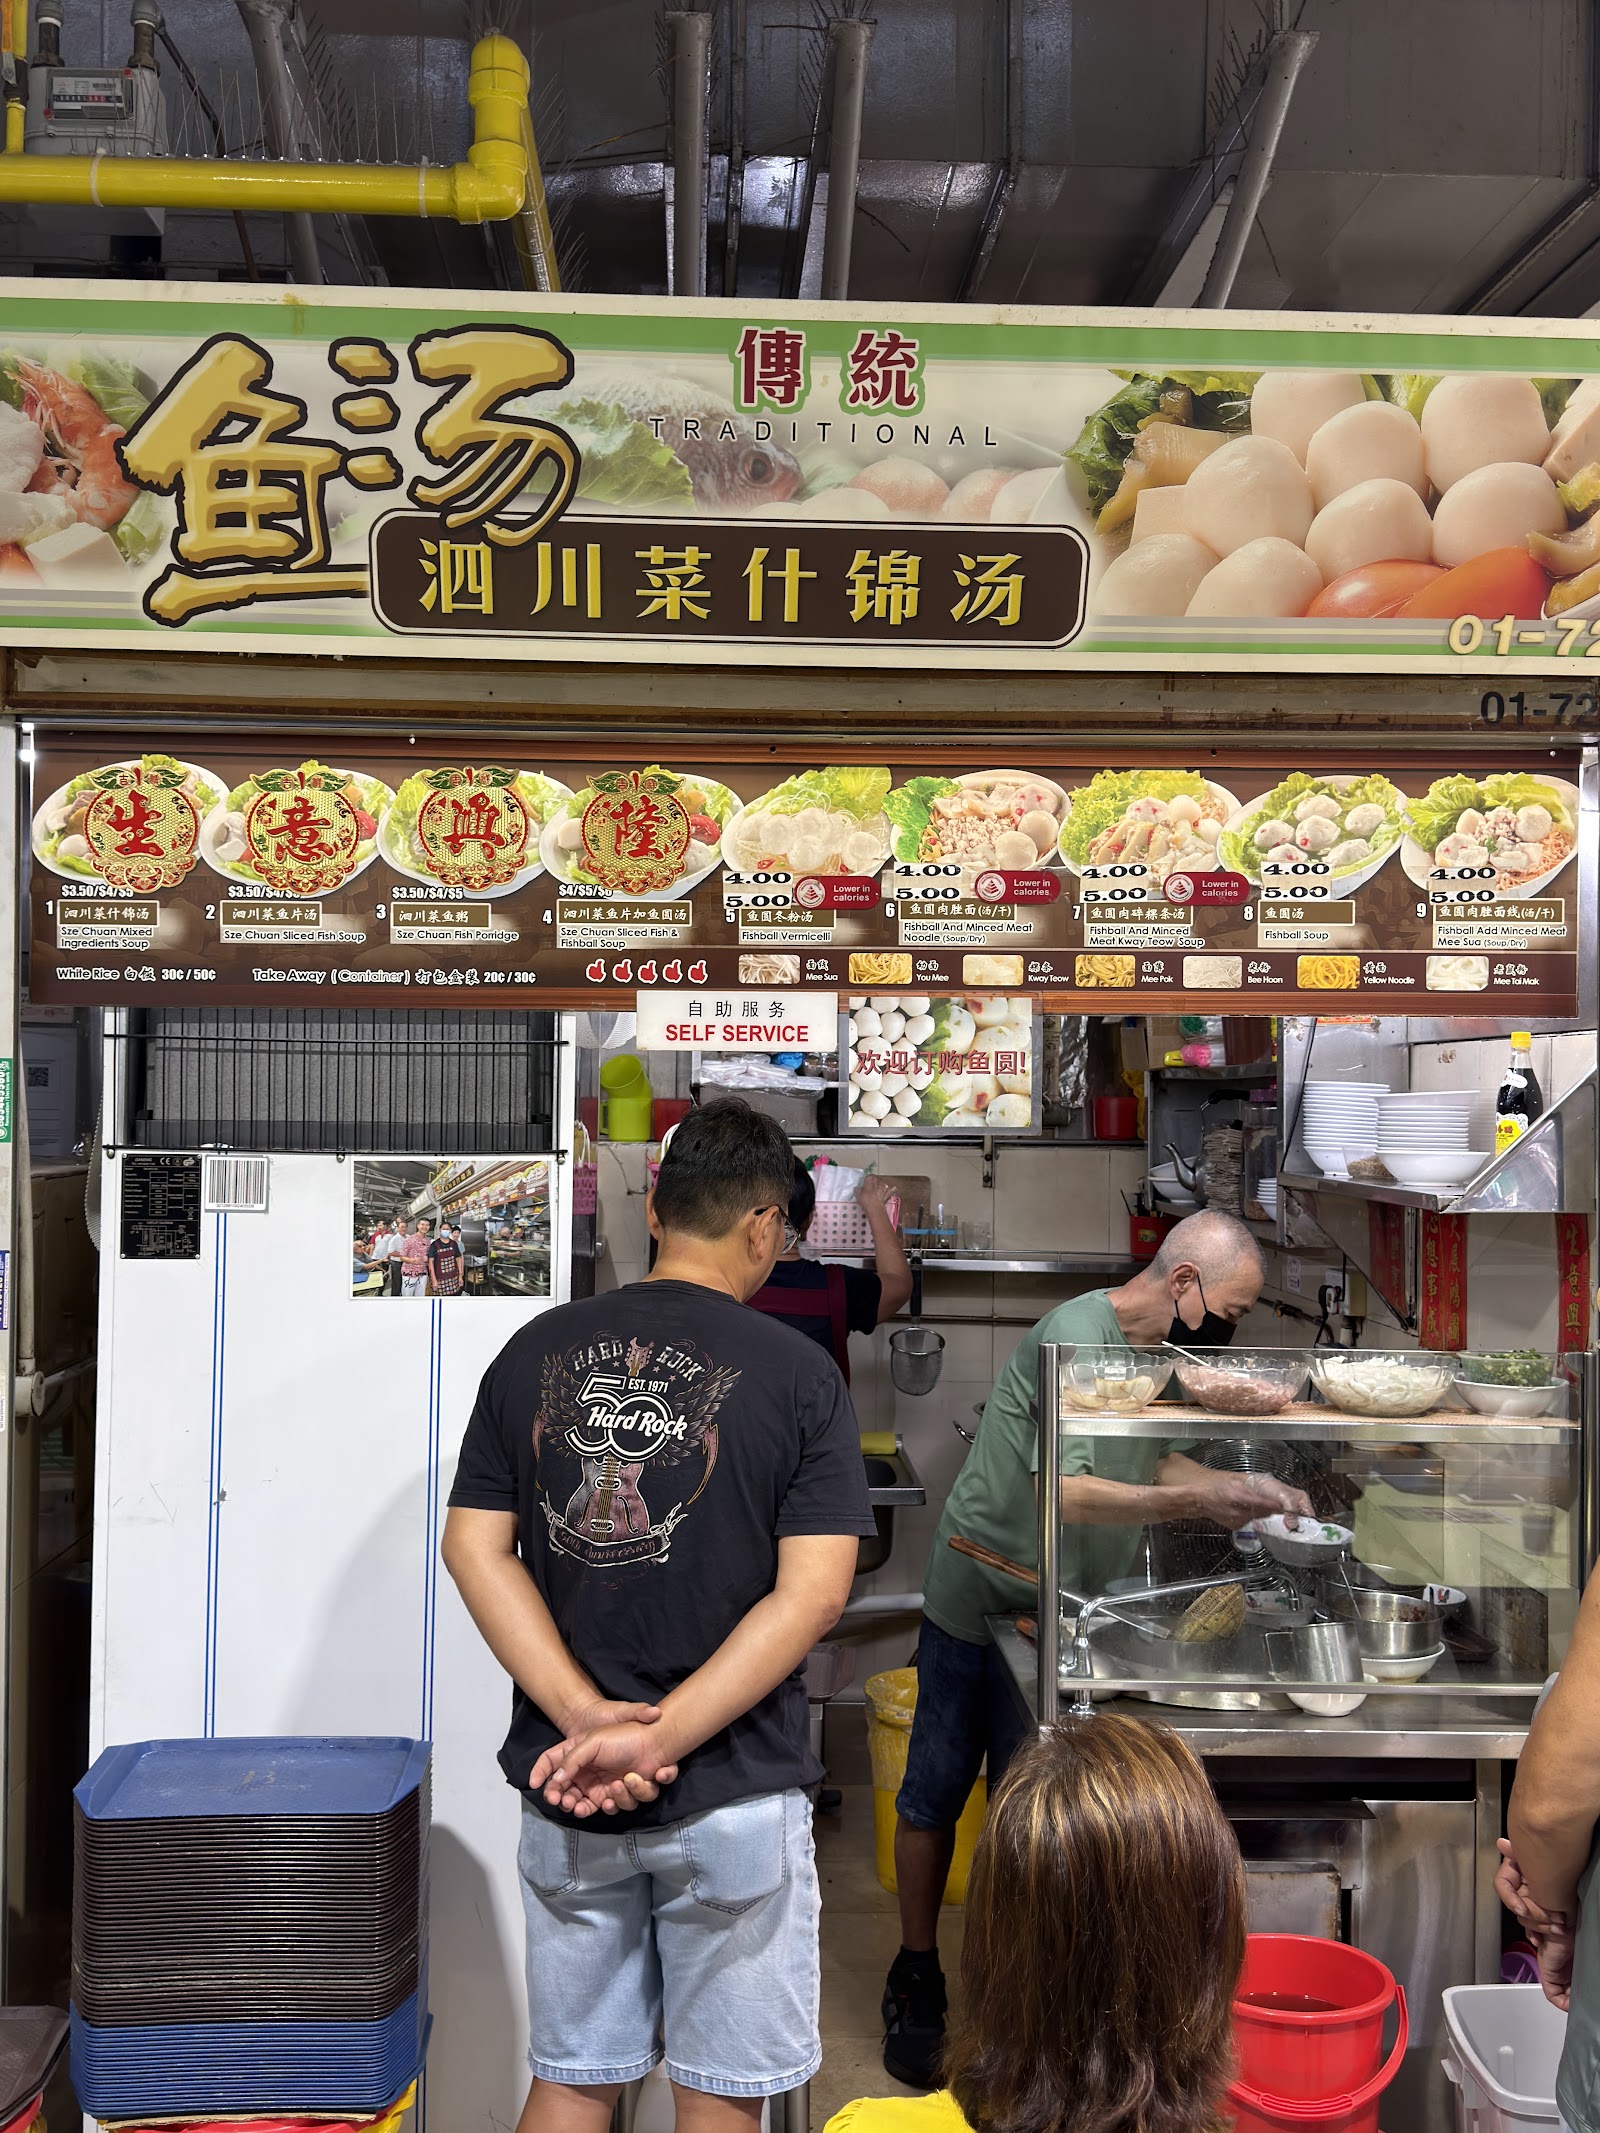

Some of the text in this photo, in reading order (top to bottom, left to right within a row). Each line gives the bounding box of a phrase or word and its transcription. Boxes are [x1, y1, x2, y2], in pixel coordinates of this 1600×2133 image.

[737, 326, 918, 410] 傳統
[649, 417, 999, 448] TRADITIONAL
[114, 323, 580, 628] 鱼汤
[417, 536, 1026, 627] 泗川菜什锦汤
[105, 788, 165, 858] 生
[266, 795, 334, 864] 意
[895, 864, 961, 877] 4.00
[1081, 864, 1148, 878] 4.00
[1264, 863, 1330, 876] 4.00
[1429, 867, 1496, 880] 4.00
[725, 872, 792, 884] 4.00
[1013, 879, 1051, 887] Lower in
[1201, 880, 1239, 888] Lower in
[391, 886, 464, 900] $3.50/$4/$5
[833, 884, 871, 893] Lower in
[895, 887, 960, 900] 5.00
[1013, 888, 1050, 896] calories
[1083, 888, 1147, 902] 5.00
[1201, 889, 1239, 897] calories
[1264, 886, 1329, 899] 5.00
[725, 894, 791, 908] 5.00
[833, 894, 870, 902] calories
[1430, 890, 1496, 903] 5.00
[45, 900, 54, 915] 1
[205, 904, 215, 919] 2
[376, 904, 386, 919] 3
[885, 903, 896, 918] 6
[1072, 906, 1081, 920] 7
[1243, 905, 1254, 921] 8
[1264, 907, 1305, 920] 鱼圆汤
[1416, 903, 1427, 918] 9
[542, 909, 553, 924] 4
[725, 909, 736, 923] 5
[61, 927, 152, 936] Sze Chuan Mixed
[560, 927, 678, 937] Sze Chuan Sliced Fish &
[904, 923, 1033, 933] Fishball And Minced Meat
[1089, 926, 1189, 935] Fishball And Minced
[1438, 926, 1567, 936] Fishball Add Minced Meat
[224, 931, 366, 943] Sze Chuan Sliced Fish Soup
[397, 930, 519, 942] Sze Chuan Fish Porridge
[742, 931, 832, 941] Fishball Vermicelli
[904, 933, 986, 944] Noodle (Soup/Dry)
[1265, 931, 1329, 941] Fishball Soup
[61, 939, 149, 949] Ingredients Soup
[561, 939, 626, 950] Fishball Soup
[1089, 938, 1204, 948] Meat Kway Teow Soup
[1437, 938, 1527, 948] Mee Sua (Soup/Dry)
[57, 968, 93, 980] White
[94, 969, 120, 980] Rice
[252, 968, 288, 981] Take
[286, 969, 326, 984] Away
[805, 973, 839, 981] Mee Sua
[916, 973, 950, 982] You Mee
[1028, 975, 1050, 984] Kway
[1141, 975, 1174, 983] Mee Pok
[1247, 976, 1283, 984] Bee Hoon
[1363, 976, 1416, 985] Yellow Noodle
[688, 1000, 786, 1018] 自助服务
[665, 1024, 809, 1043] SELF SERVICE
[856, 1048, 1027, 1076] 欢迎订购鱼圆!
[571, 1339, 706, 1382] HARD ROCK
[628, 1378, 669, 1394] EST. 1971
[586, 1405, 688, 1441] Hard Rock
